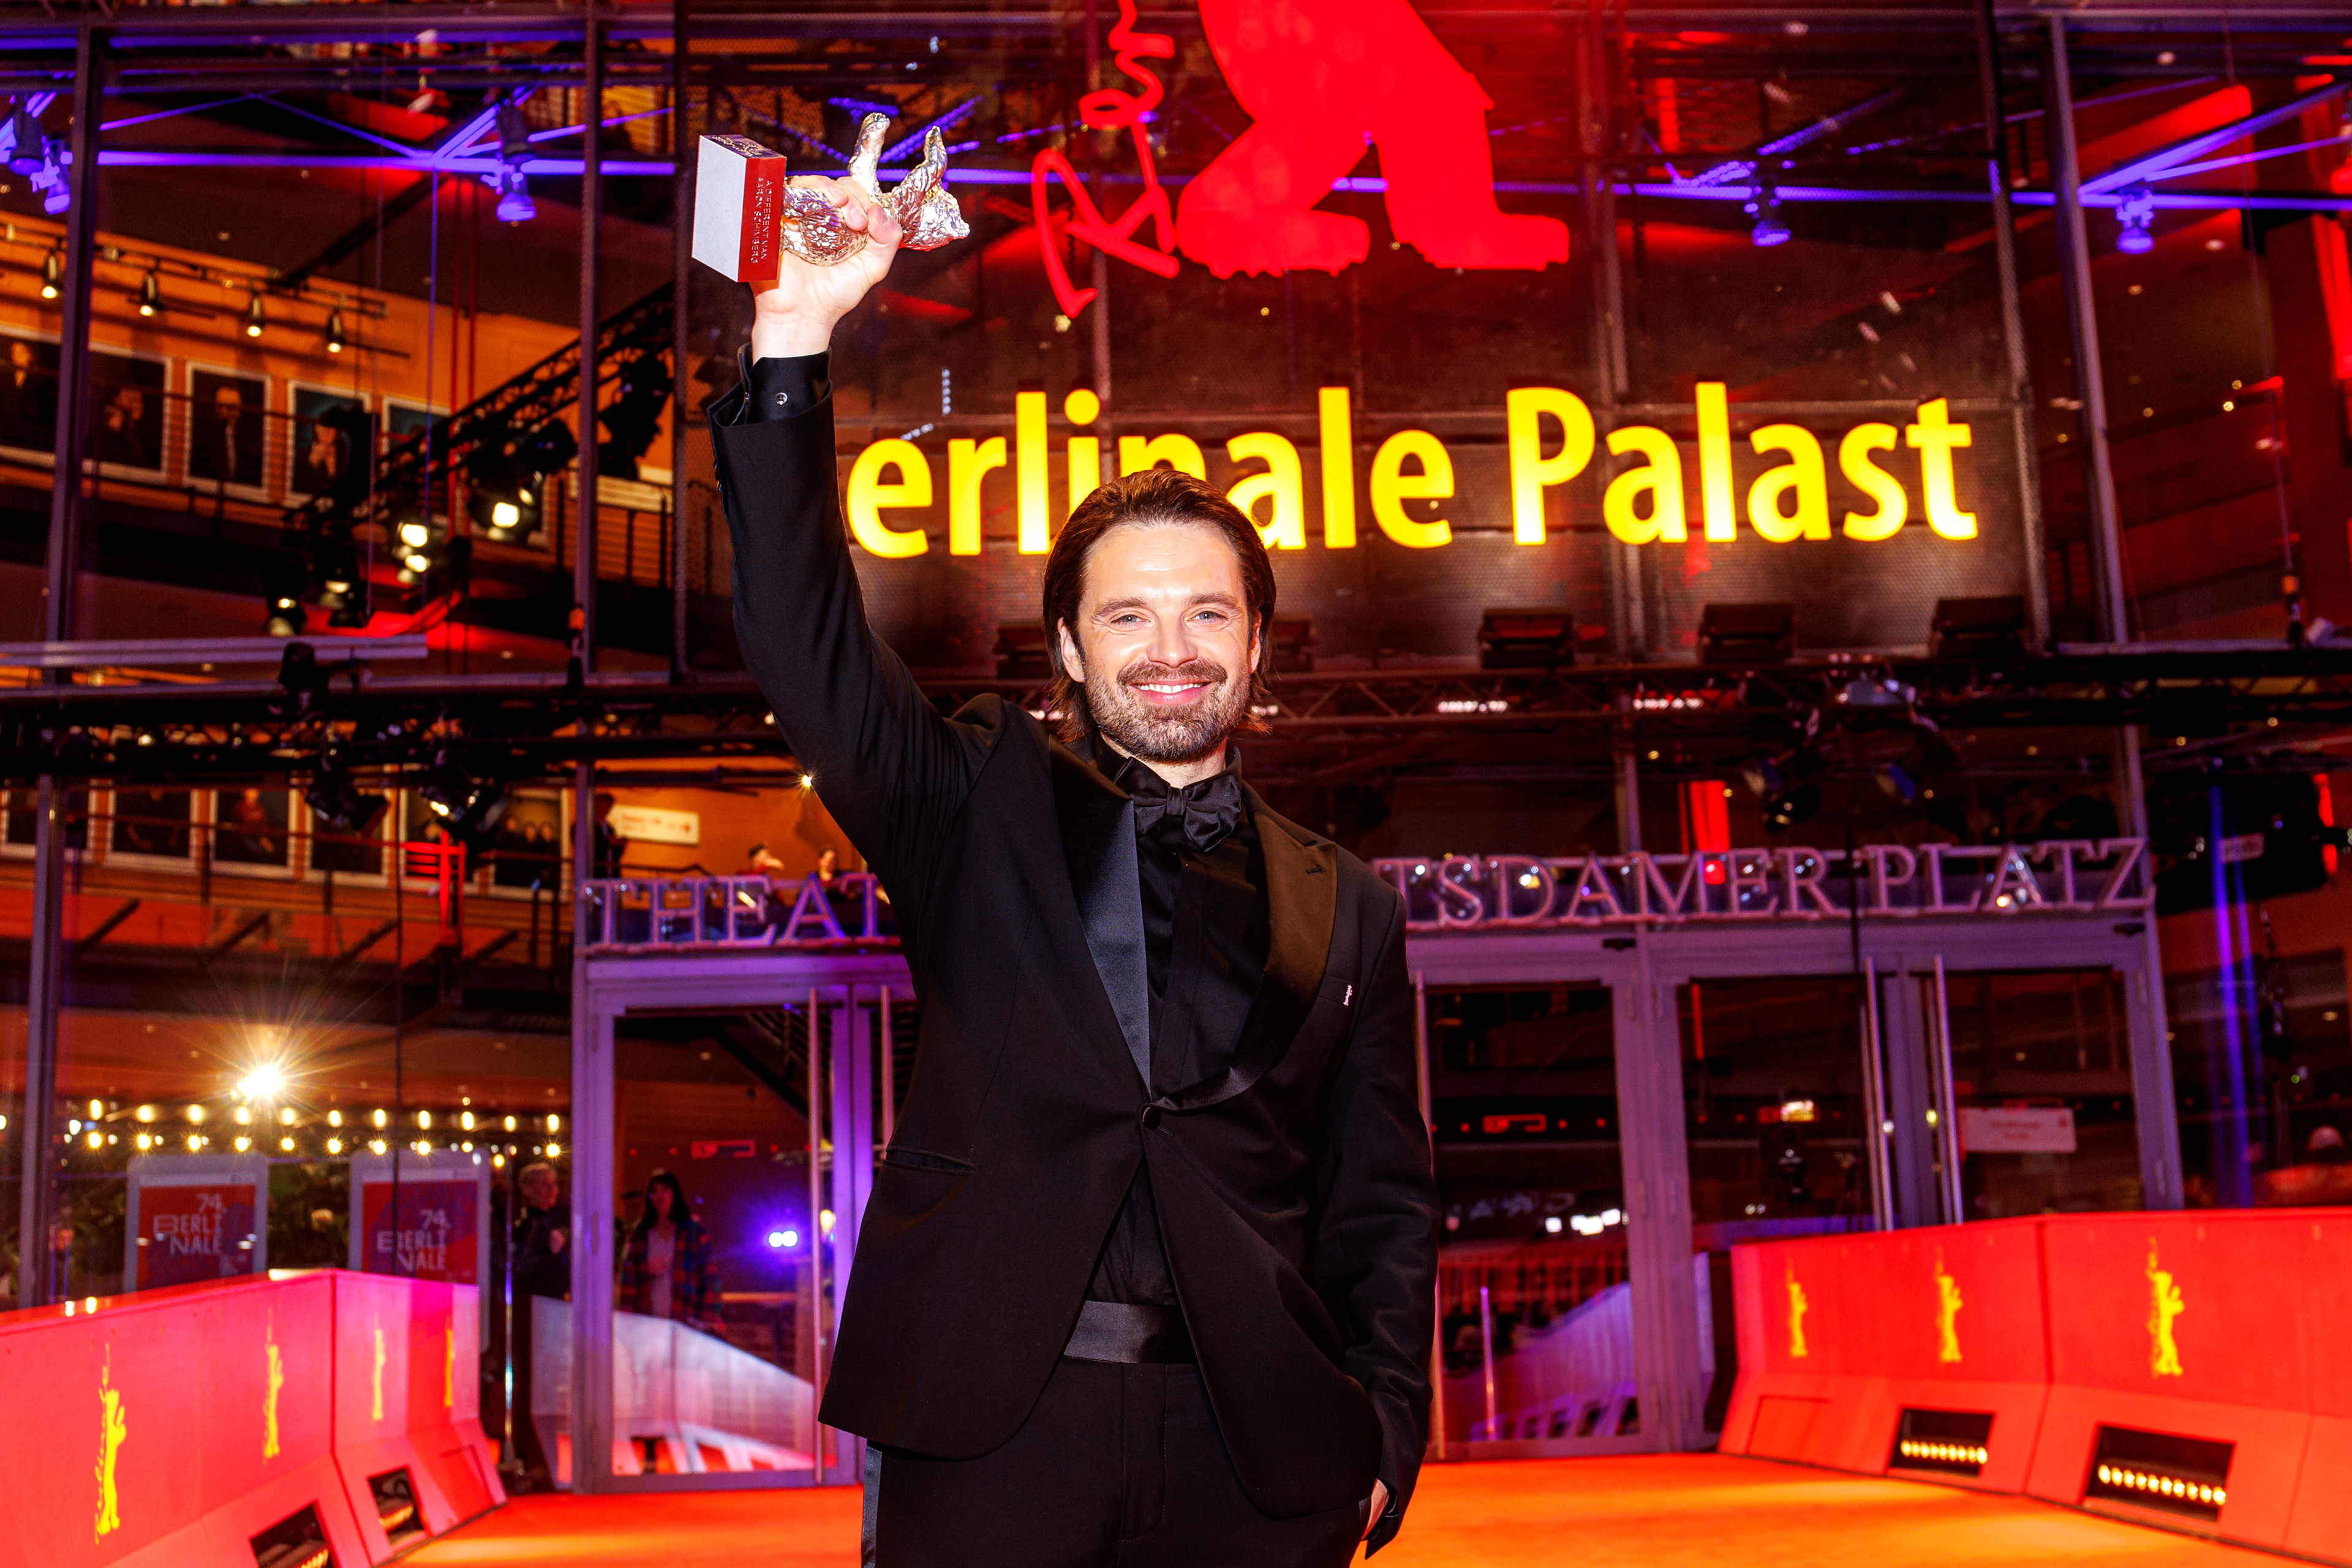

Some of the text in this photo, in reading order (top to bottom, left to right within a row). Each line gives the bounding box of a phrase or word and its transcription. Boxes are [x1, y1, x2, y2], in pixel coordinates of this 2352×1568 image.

[750, 176, 764, 263] AARON SCHIMBERG
[762, 187, 772, 238] DIFFERENT
[847, 381, 1978, 558] erliale Palast
[1859, 837, 2155, 916] PLATZ
